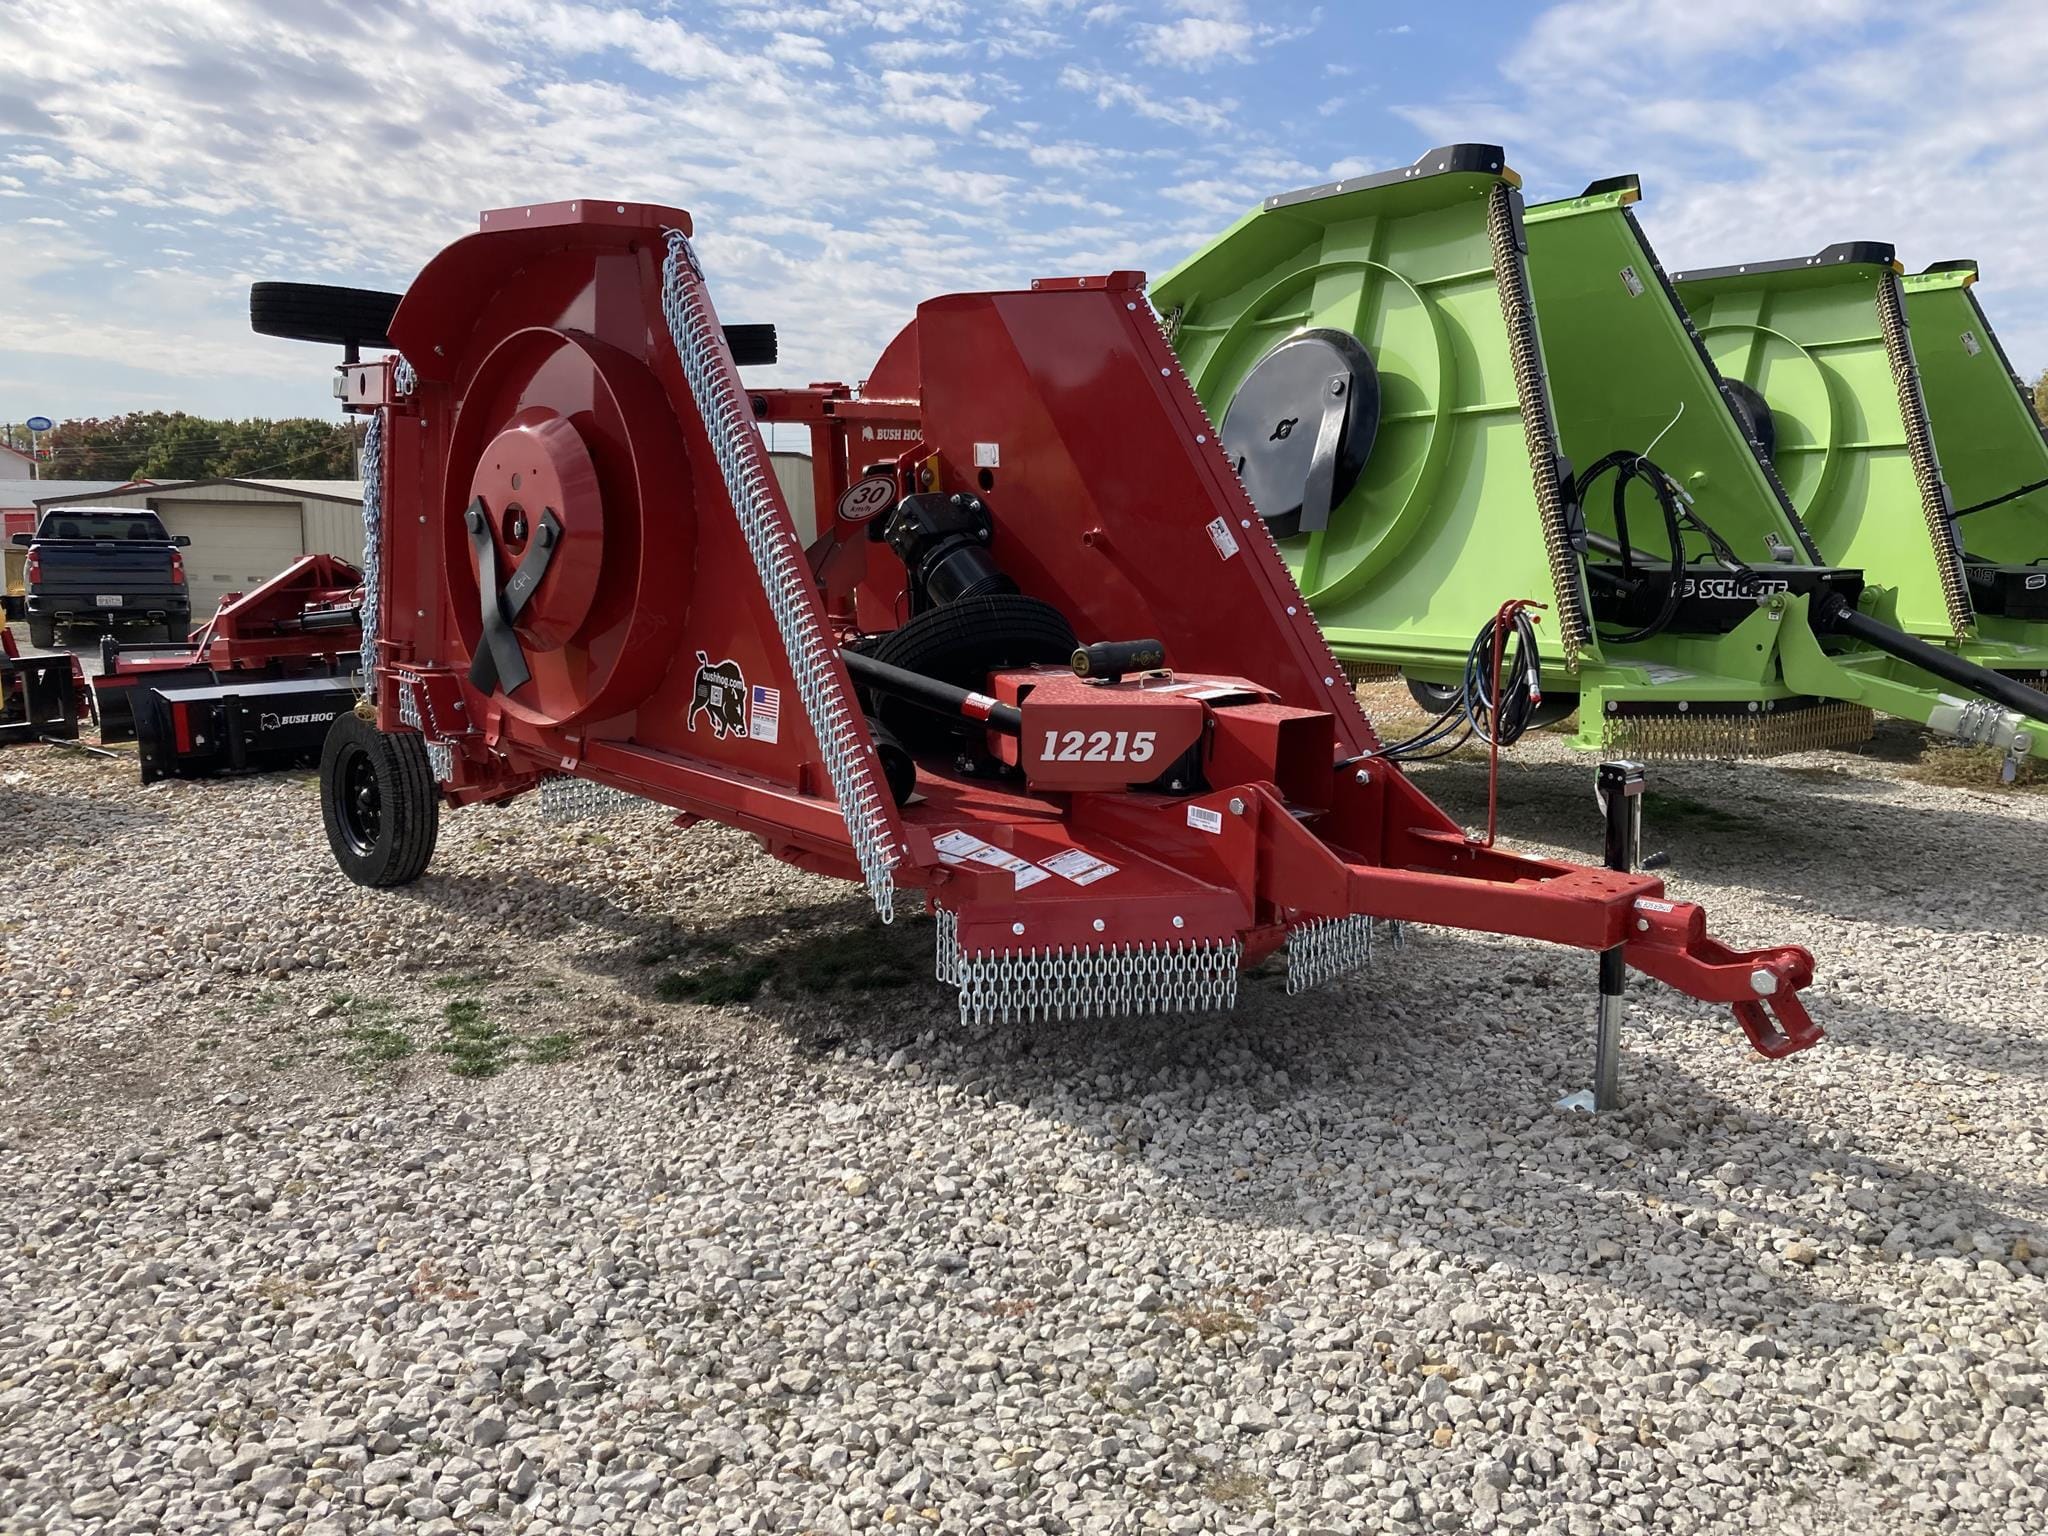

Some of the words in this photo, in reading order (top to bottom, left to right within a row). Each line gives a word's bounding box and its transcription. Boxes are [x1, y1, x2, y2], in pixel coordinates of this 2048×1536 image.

[877, 429, 901, 440] BUSH
[853, 486, 885, 504] 30
[703, 669, 743, 689] bushhog.com
[281, 715, 309, 725] BUSH
[310, 712, 333, 722] HOG
[1040, 731, 1157, 762] 12215
